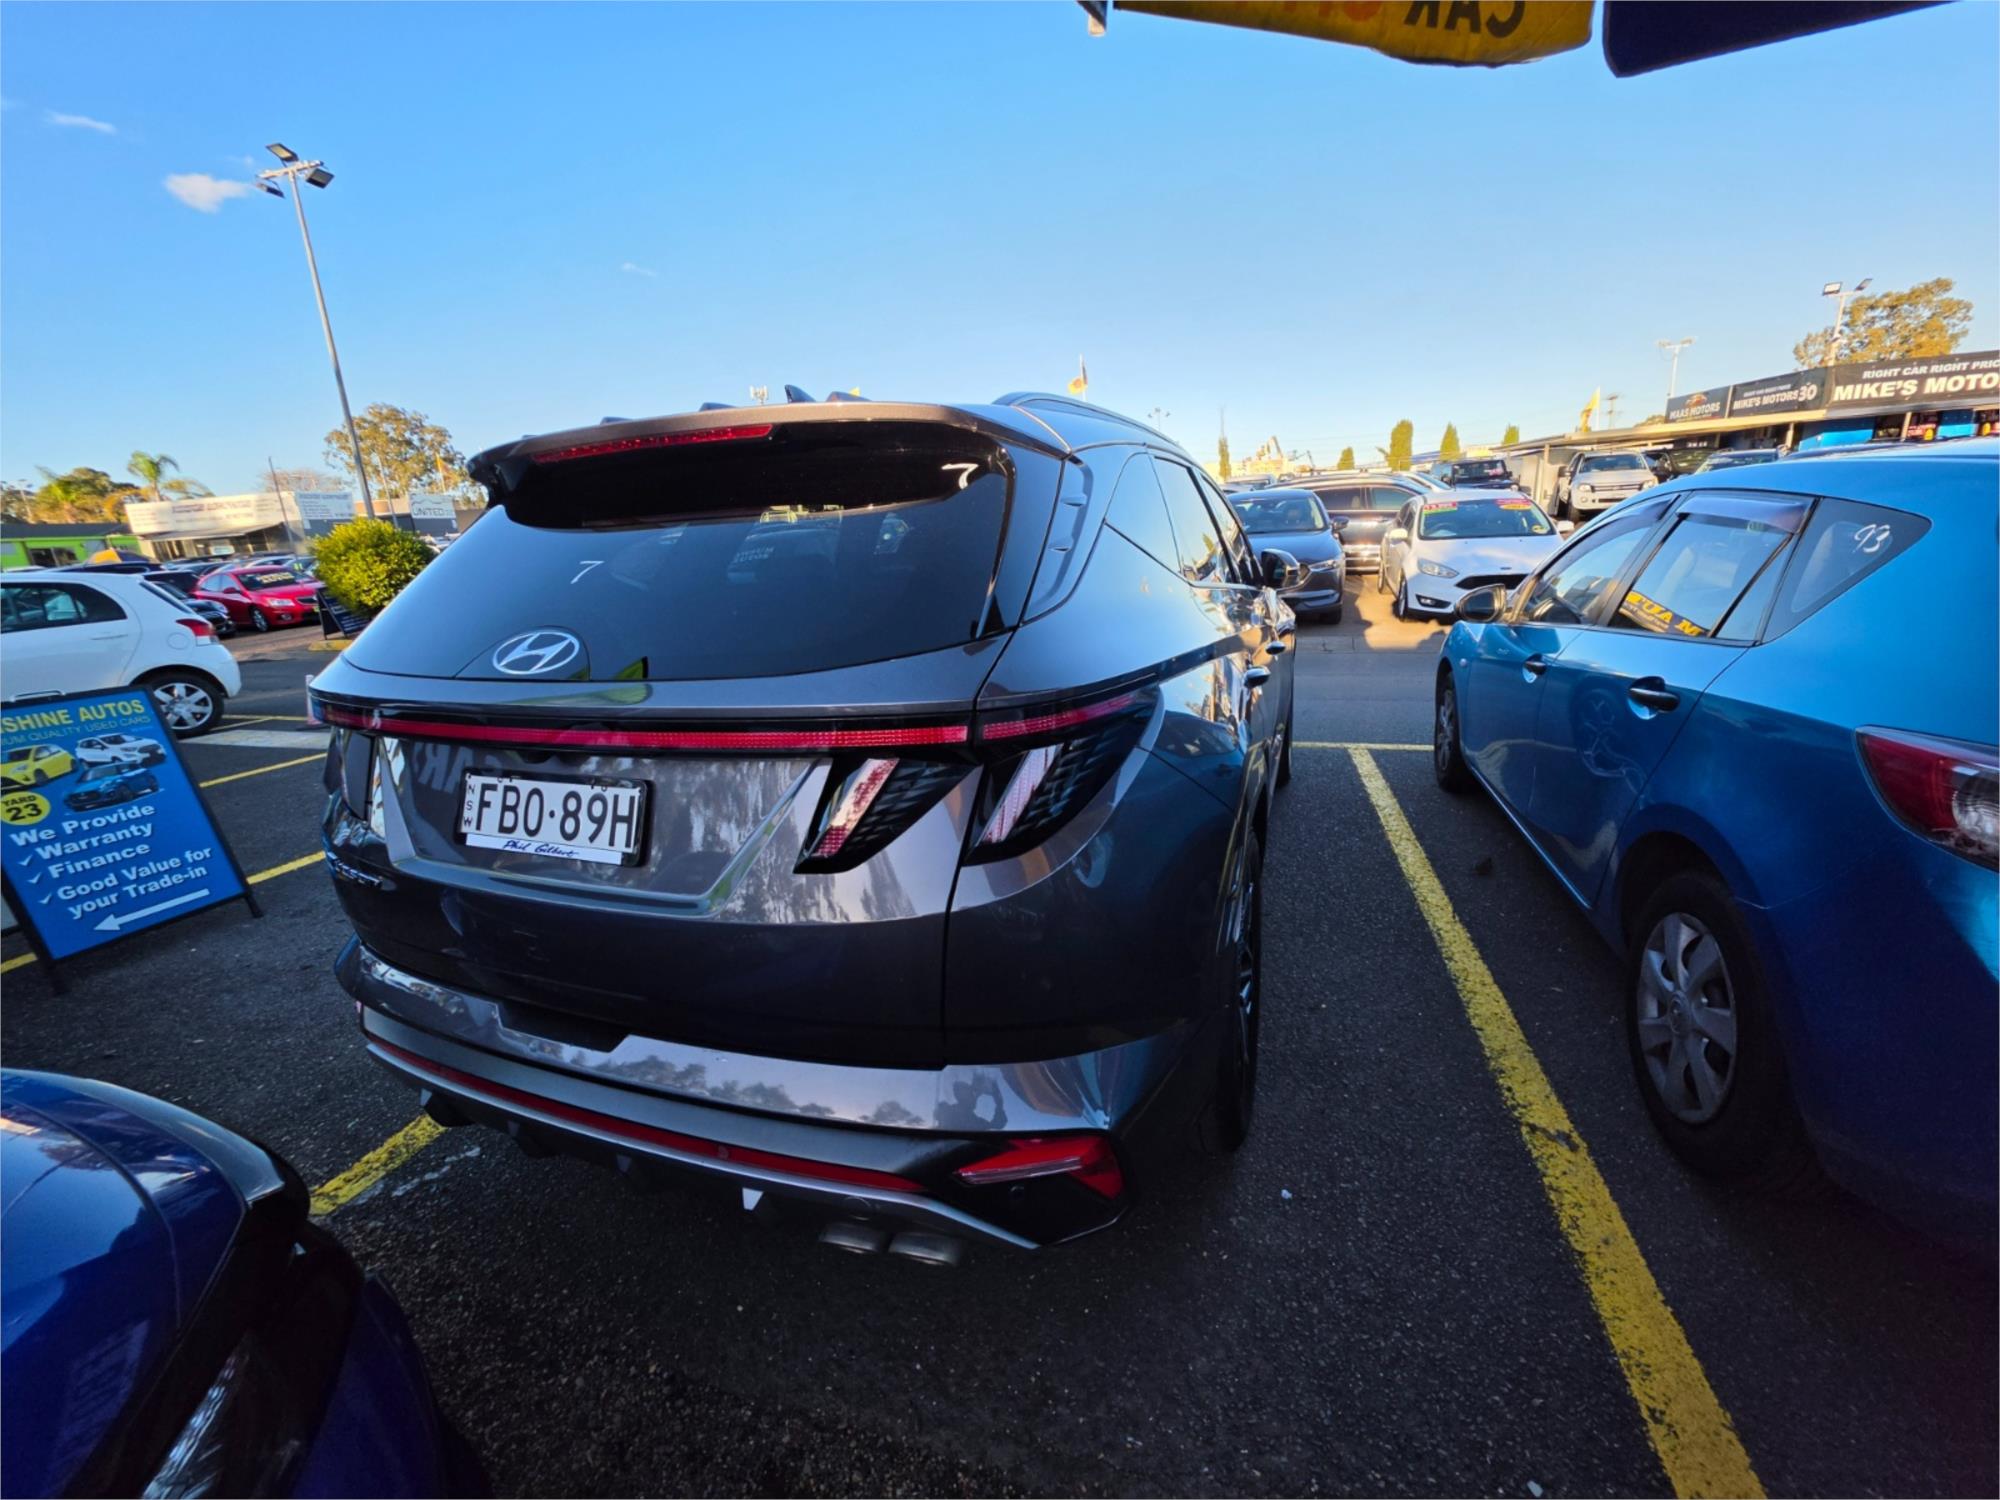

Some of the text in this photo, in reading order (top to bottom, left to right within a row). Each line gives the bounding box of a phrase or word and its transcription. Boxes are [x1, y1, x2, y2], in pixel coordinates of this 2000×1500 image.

[1833, 372, 2000, 401] MIKE'S MOTO
[1862, 368, 1901, 379] RIGHT
[1903, 365, 1928, 376] CAR
[1930, 362, 1969, 373] RIGHT
[0, 699, 145, 734] SHINE AUTOS
[86, 721, 118, 733] USED
[119, 715, 150, 727] CARS
[6, 803, 42, 821] 23
[9, 804, 155, 846] We Provide
[35, 822, 153, 859] Warranty
[48, 844, 150, 879] Finance
[57, 847, 212, 900] Good Value for
[68, 865, 208, 920] your Trade-in
